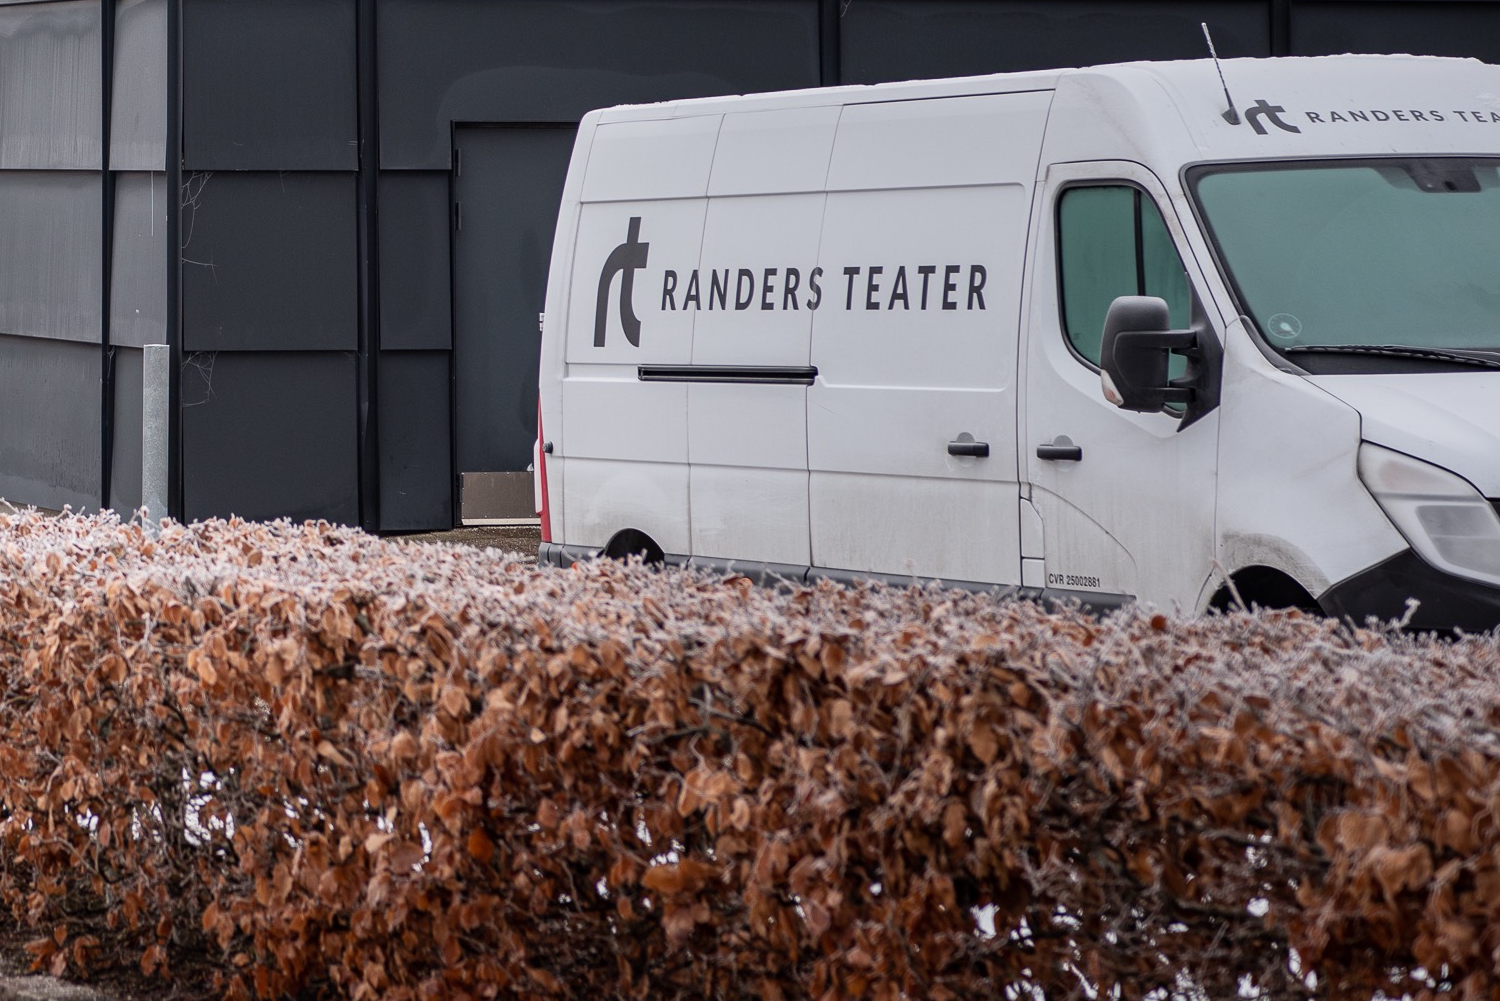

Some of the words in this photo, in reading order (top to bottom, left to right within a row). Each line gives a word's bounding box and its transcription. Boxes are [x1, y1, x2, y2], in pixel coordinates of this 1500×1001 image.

[1304, 110, 1445, 124] RANDERS
[661, 266, 824, 311] RANDERS
[843, 264, 988, 311] TEATER
[1049, 573, 1064, 585] CVR
